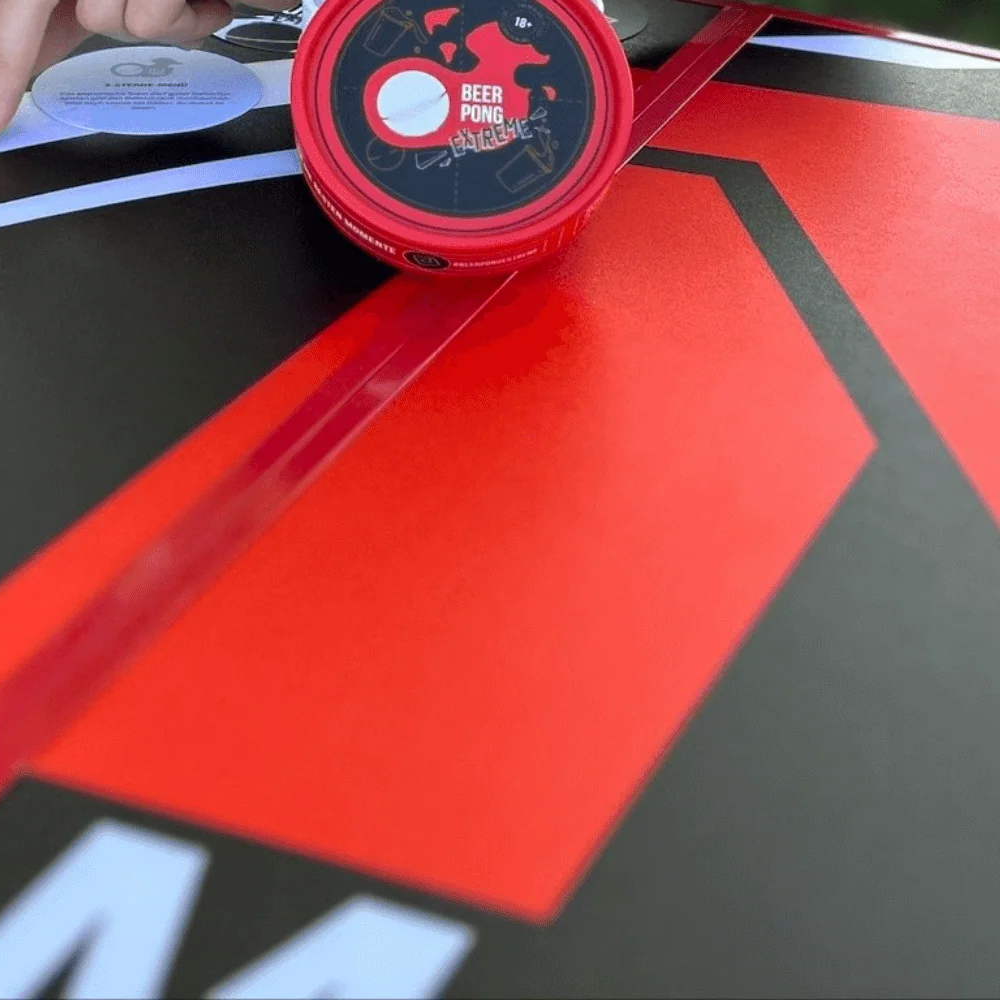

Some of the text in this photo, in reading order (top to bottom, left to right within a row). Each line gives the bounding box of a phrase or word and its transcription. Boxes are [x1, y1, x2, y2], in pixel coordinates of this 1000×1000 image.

[514, 16, 533, 29] 18+
[461, 83, 503, 104] BEER
[460, 103, 504, 125] PONG
[449, 117, 534, 158] EXTREME
